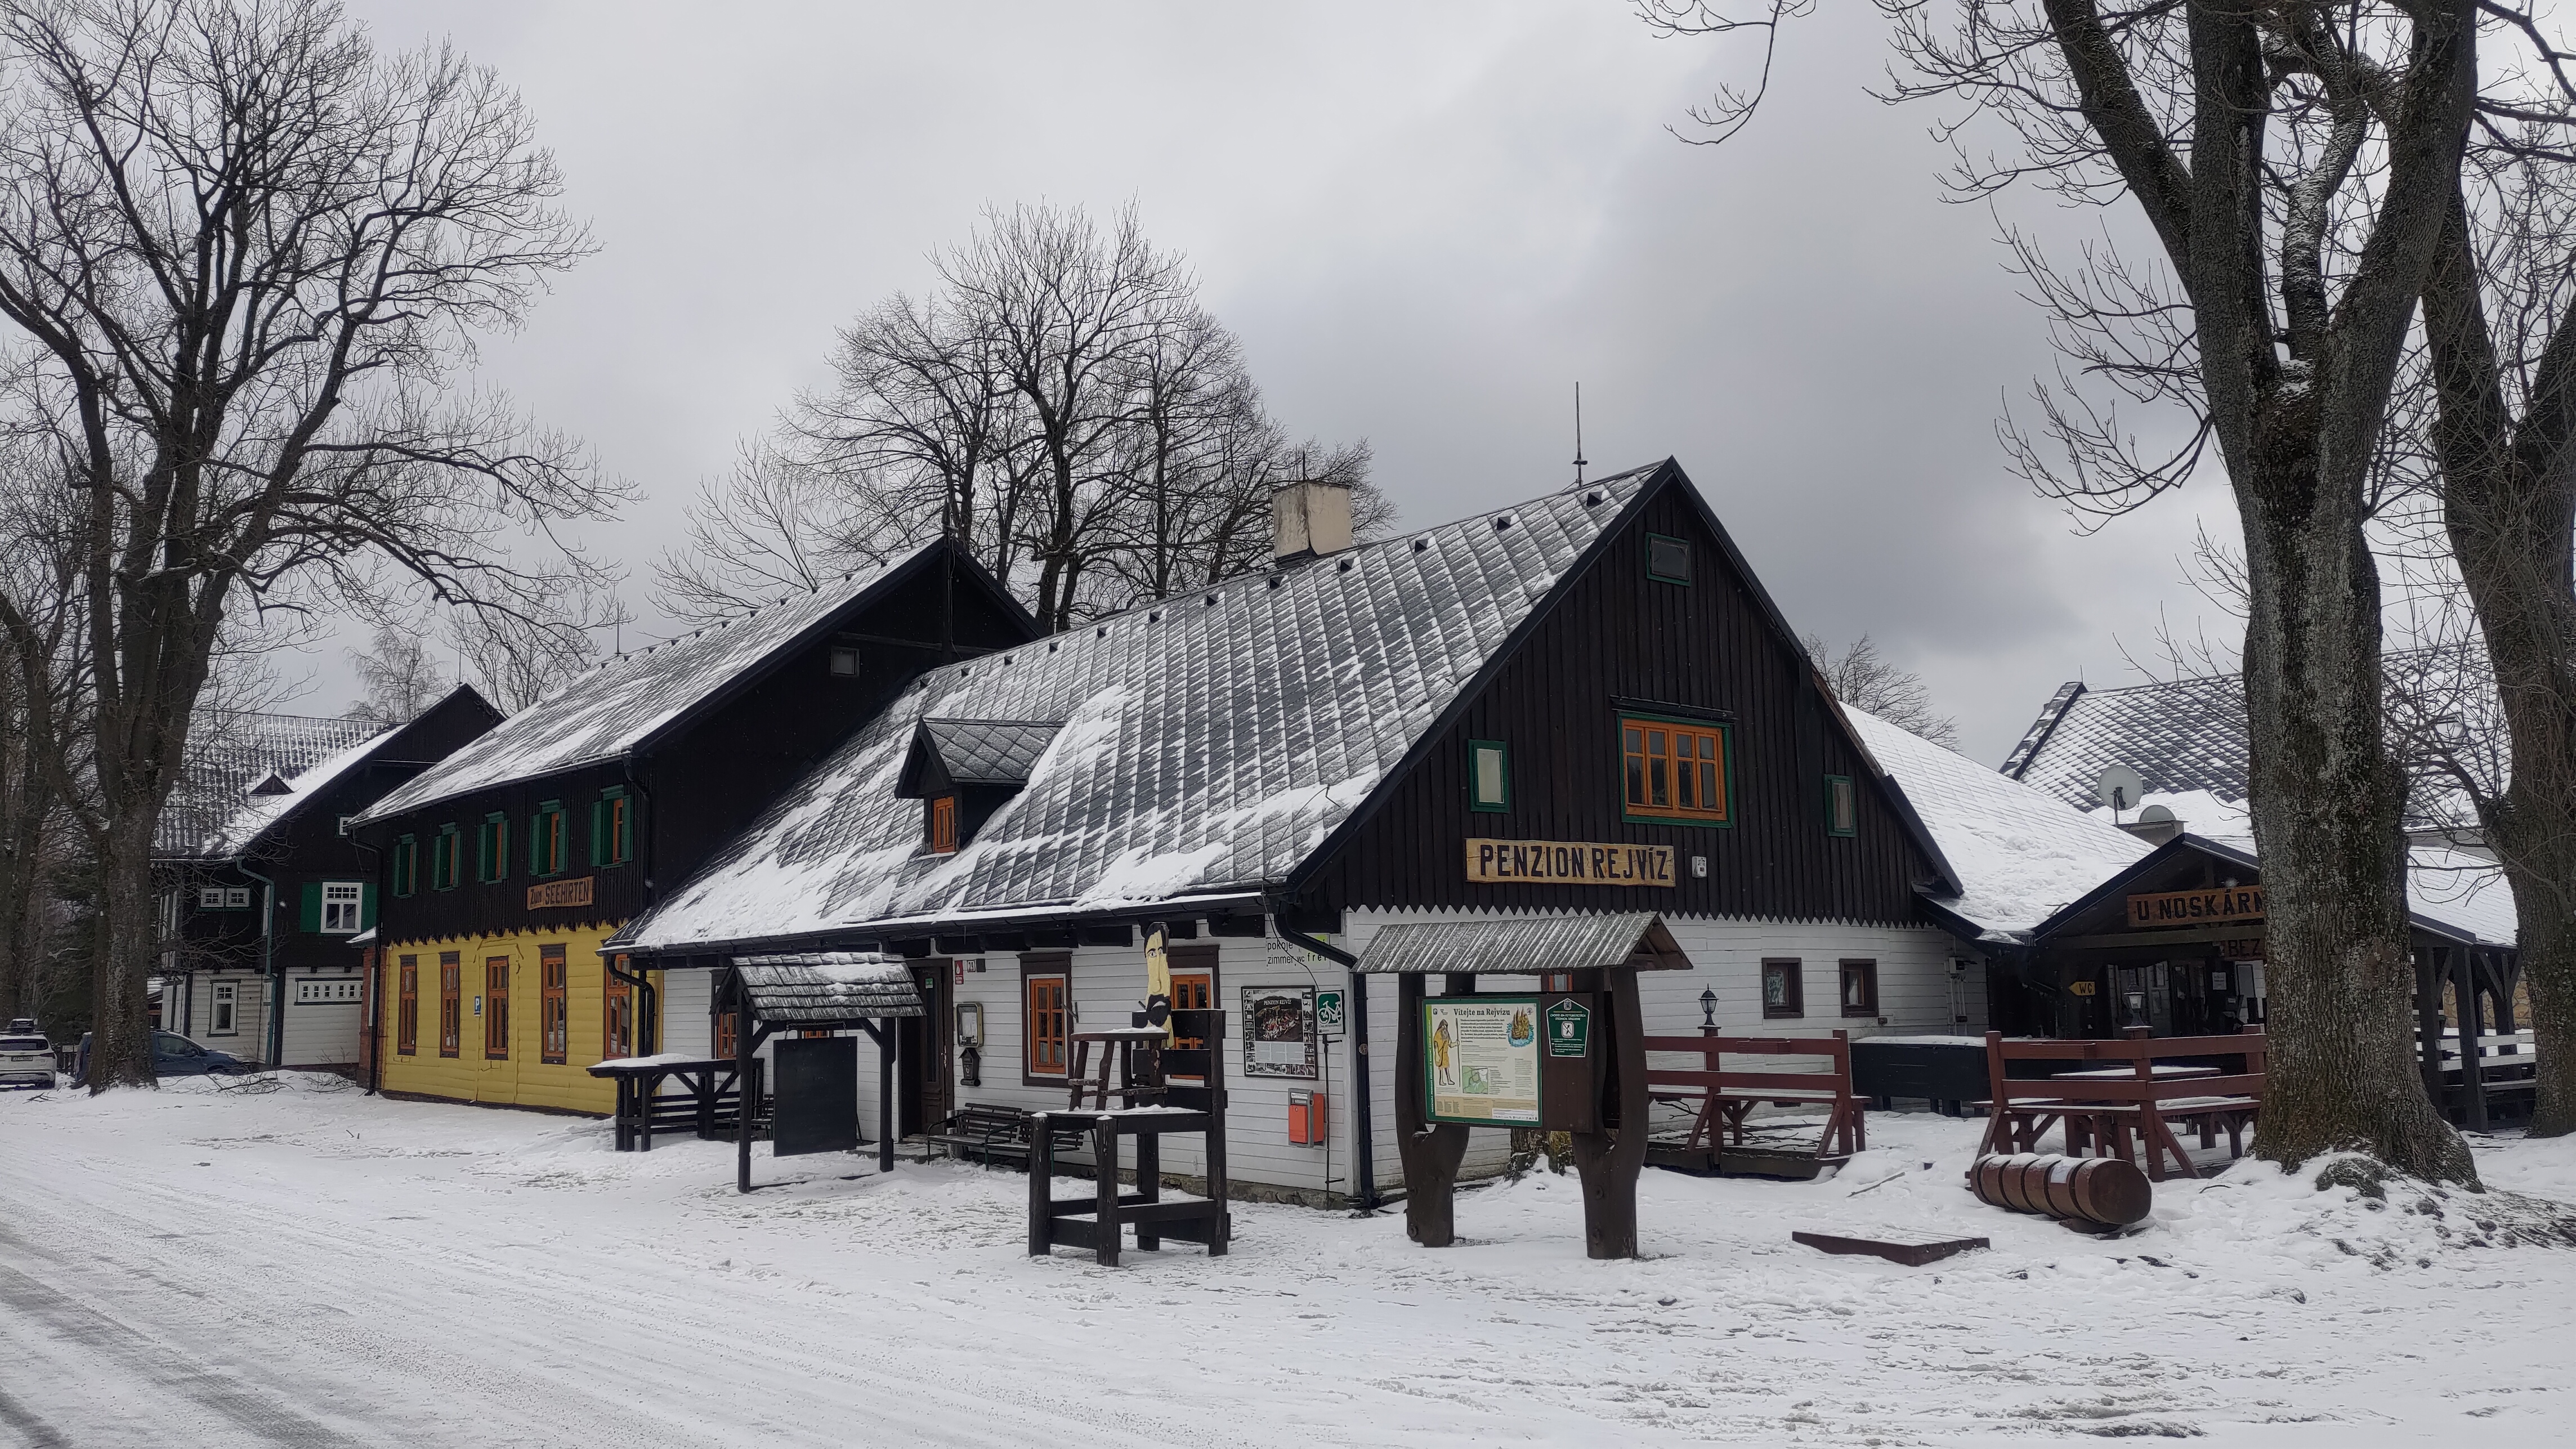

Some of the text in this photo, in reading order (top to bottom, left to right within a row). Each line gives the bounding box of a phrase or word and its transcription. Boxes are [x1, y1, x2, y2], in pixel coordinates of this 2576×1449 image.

[1480, 844, 1669, 880] PENZION REJVÍZ
[545, 880, 589, 905] SEEHIRTEN
[2137, 901, 2150, 920] U
[1267, 940, 1293, 952] pokoje
[1267, 956, 1294, 964] zimmer
[2079, 982, 2092, 994] WC
[475, 998, 480, 1010] P
